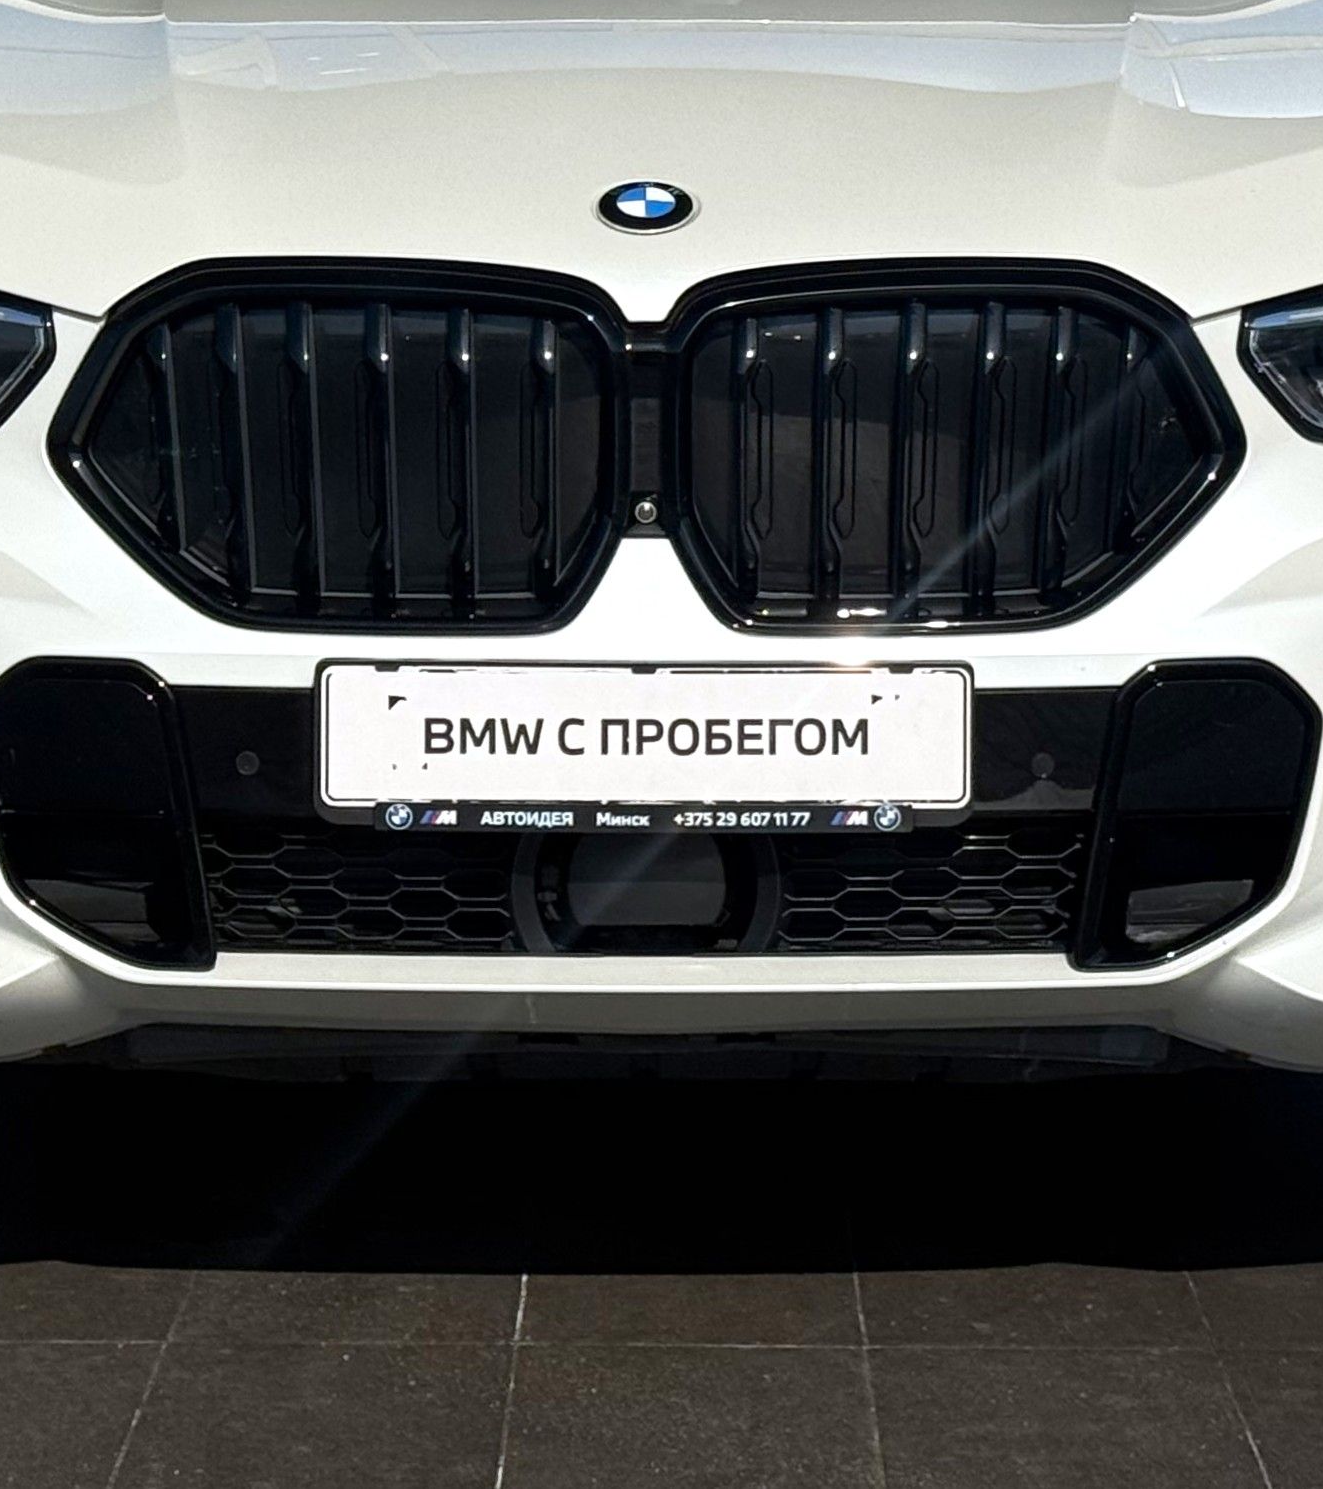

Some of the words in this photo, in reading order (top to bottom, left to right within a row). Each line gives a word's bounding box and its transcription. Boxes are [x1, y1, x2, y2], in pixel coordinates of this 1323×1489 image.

[424, 717, 544, 755] BMW
[558, 717, 585, 756] С
[601, 717, 869, 757] ПРОБЕГОМ
[480, 810, 574, 827] АВТОИДЕЯ
[595, 811, 650, 827] Минск
[673, 811, 714, 827] +375
[715, 811, 738, 827] 29
